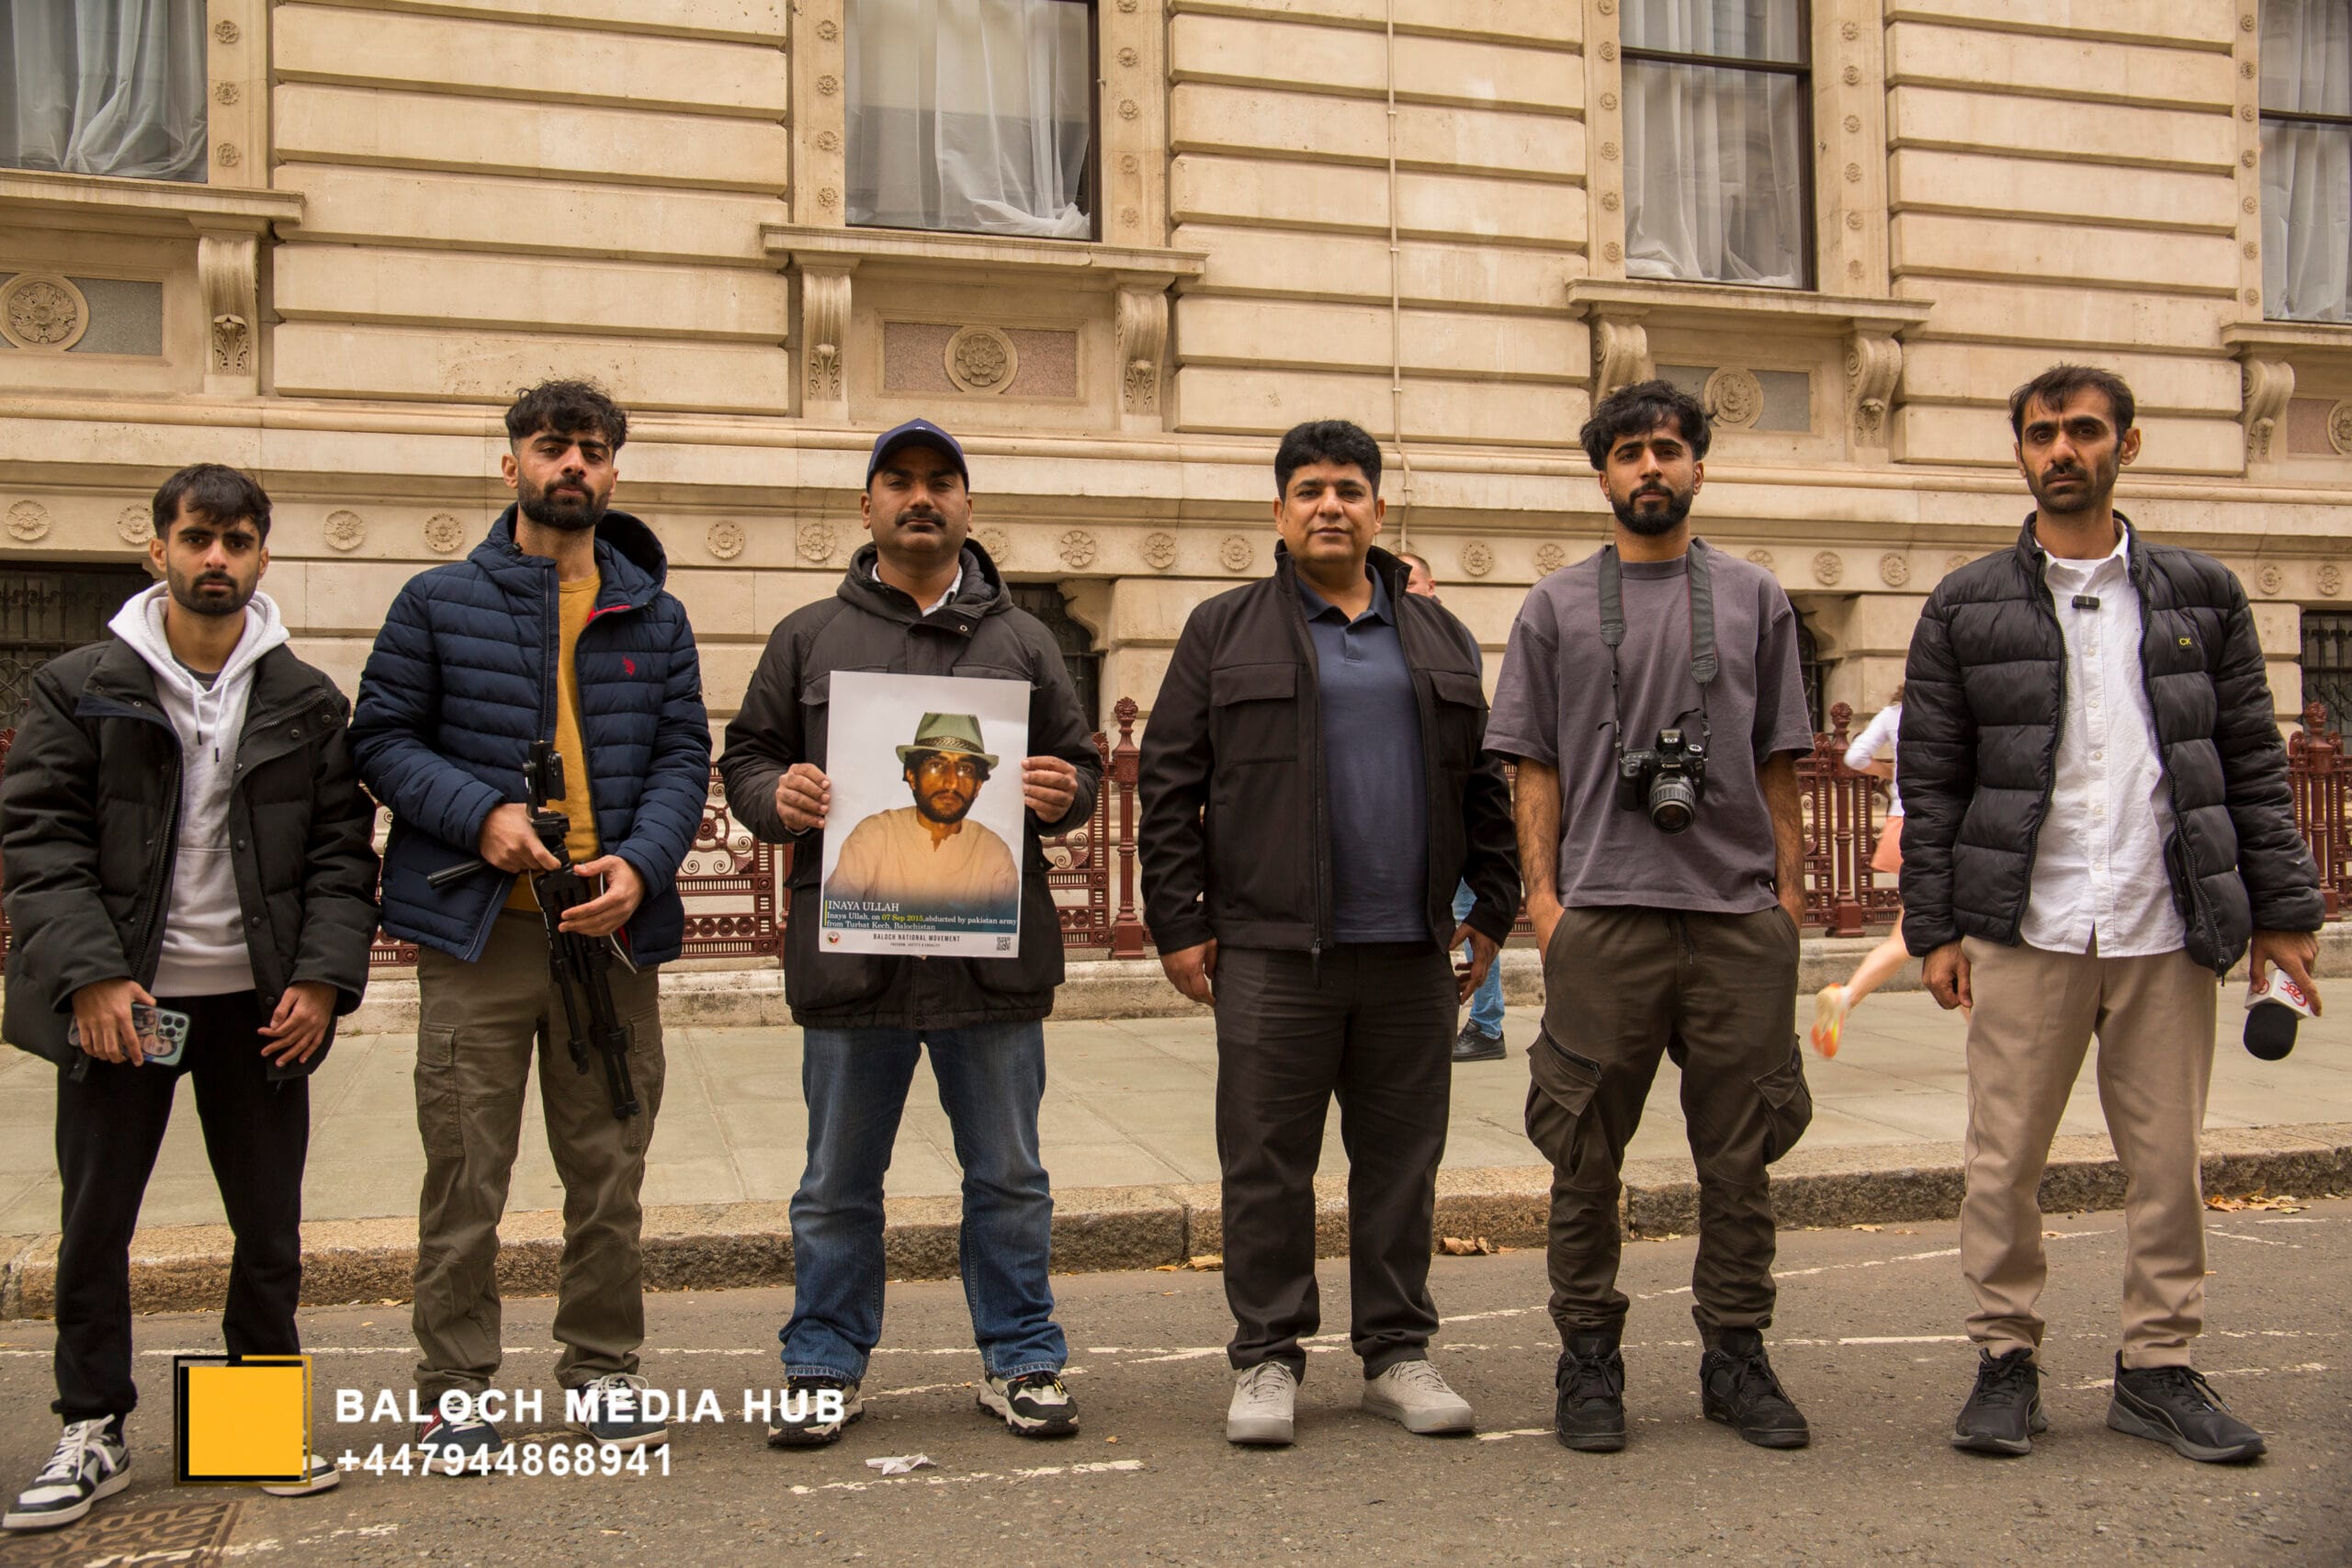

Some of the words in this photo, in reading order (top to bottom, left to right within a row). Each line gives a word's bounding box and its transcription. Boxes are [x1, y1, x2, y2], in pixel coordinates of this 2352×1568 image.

[2178, 637, 2192, 646] CK
[828, 900, 860, 911] INAYA
[862, 901, 899, 912] ULLAH
[827, 911, 847, 920] Inaya
[892, 914, 906, 922] Sep
[957, 916, 967, 924] by
[967, 917, 998, 925] pakistan
[894, 922, 936, 931] Balochistan
